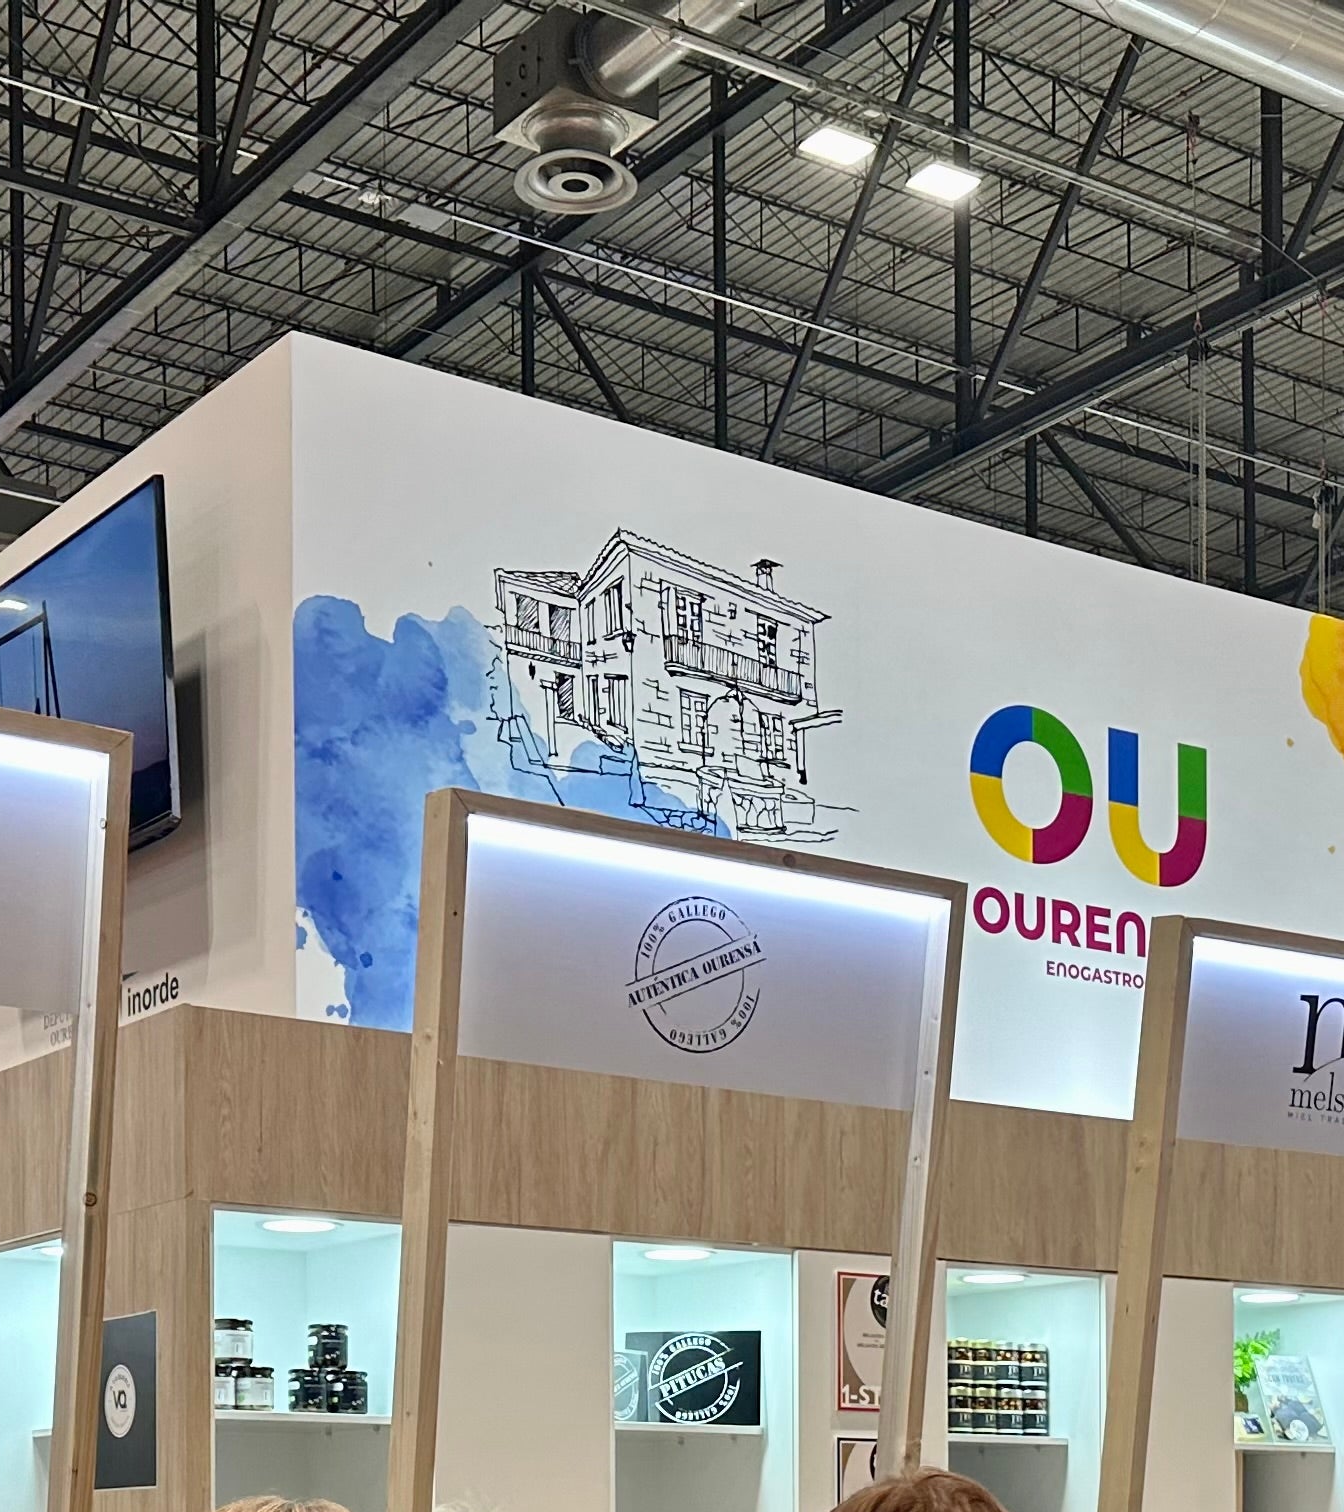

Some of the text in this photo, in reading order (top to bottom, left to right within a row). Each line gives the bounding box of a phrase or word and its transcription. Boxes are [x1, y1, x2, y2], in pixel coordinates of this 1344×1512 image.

[969, 704, 1208, 888] OU
[640, 903, 727, 960] 100% GALLEGO
[1045, 959, 1145, 990] ENOGASTRO
[669, 1027, 728, 1047] GALLEGO
[658, 1356, 727, 1399] PITUCAS
